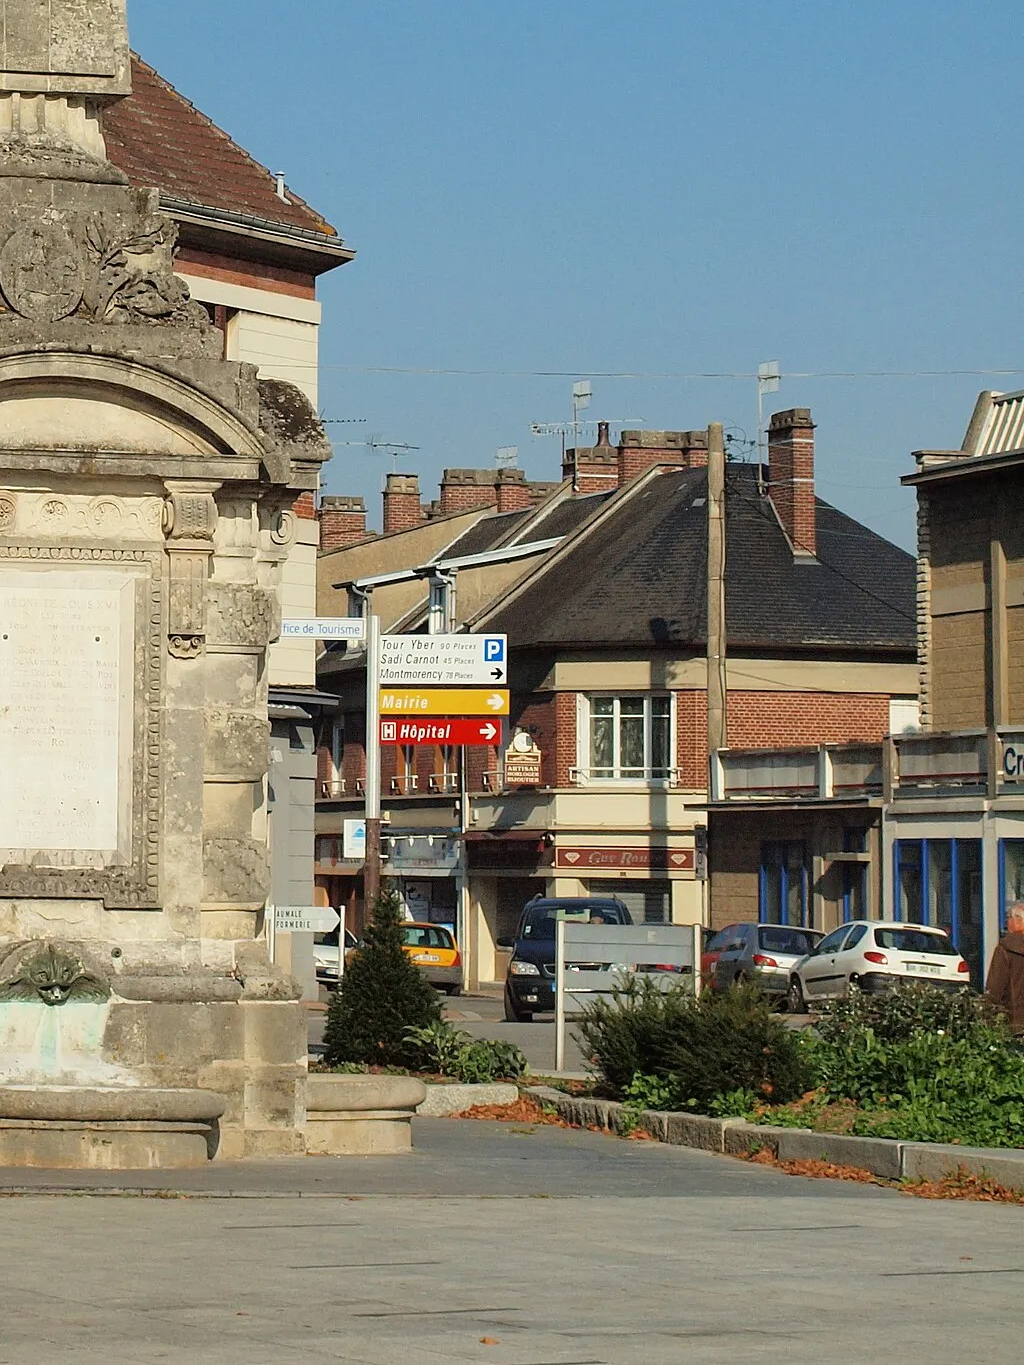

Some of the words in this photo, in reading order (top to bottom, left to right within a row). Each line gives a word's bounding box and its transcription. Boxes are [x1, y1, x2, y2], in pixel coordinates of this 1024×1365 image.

[302, 623, 314, 634] de
[317, 623, 360, 635] Tourisme
[381, 639, 404, 650] Tour
[411, 639, 435, 650] Yber
[440, 642, 450, 650] 90
[453, 642, 476, 650] Places
[487, 640, 500, 660] P
[380, 653, 403, 664] Sadi
[405, 653, 439, 664] Carnot
[379, 668, 443, 681] Montmorency
[454, 671, 474, 679] Places
[381, 694, 429, 709] Mairie
[400, 723, 451, 742] Hôpital
[276, 910, 302, 918] AUMALE
[276, 920, 311, 929] FORMERIE
